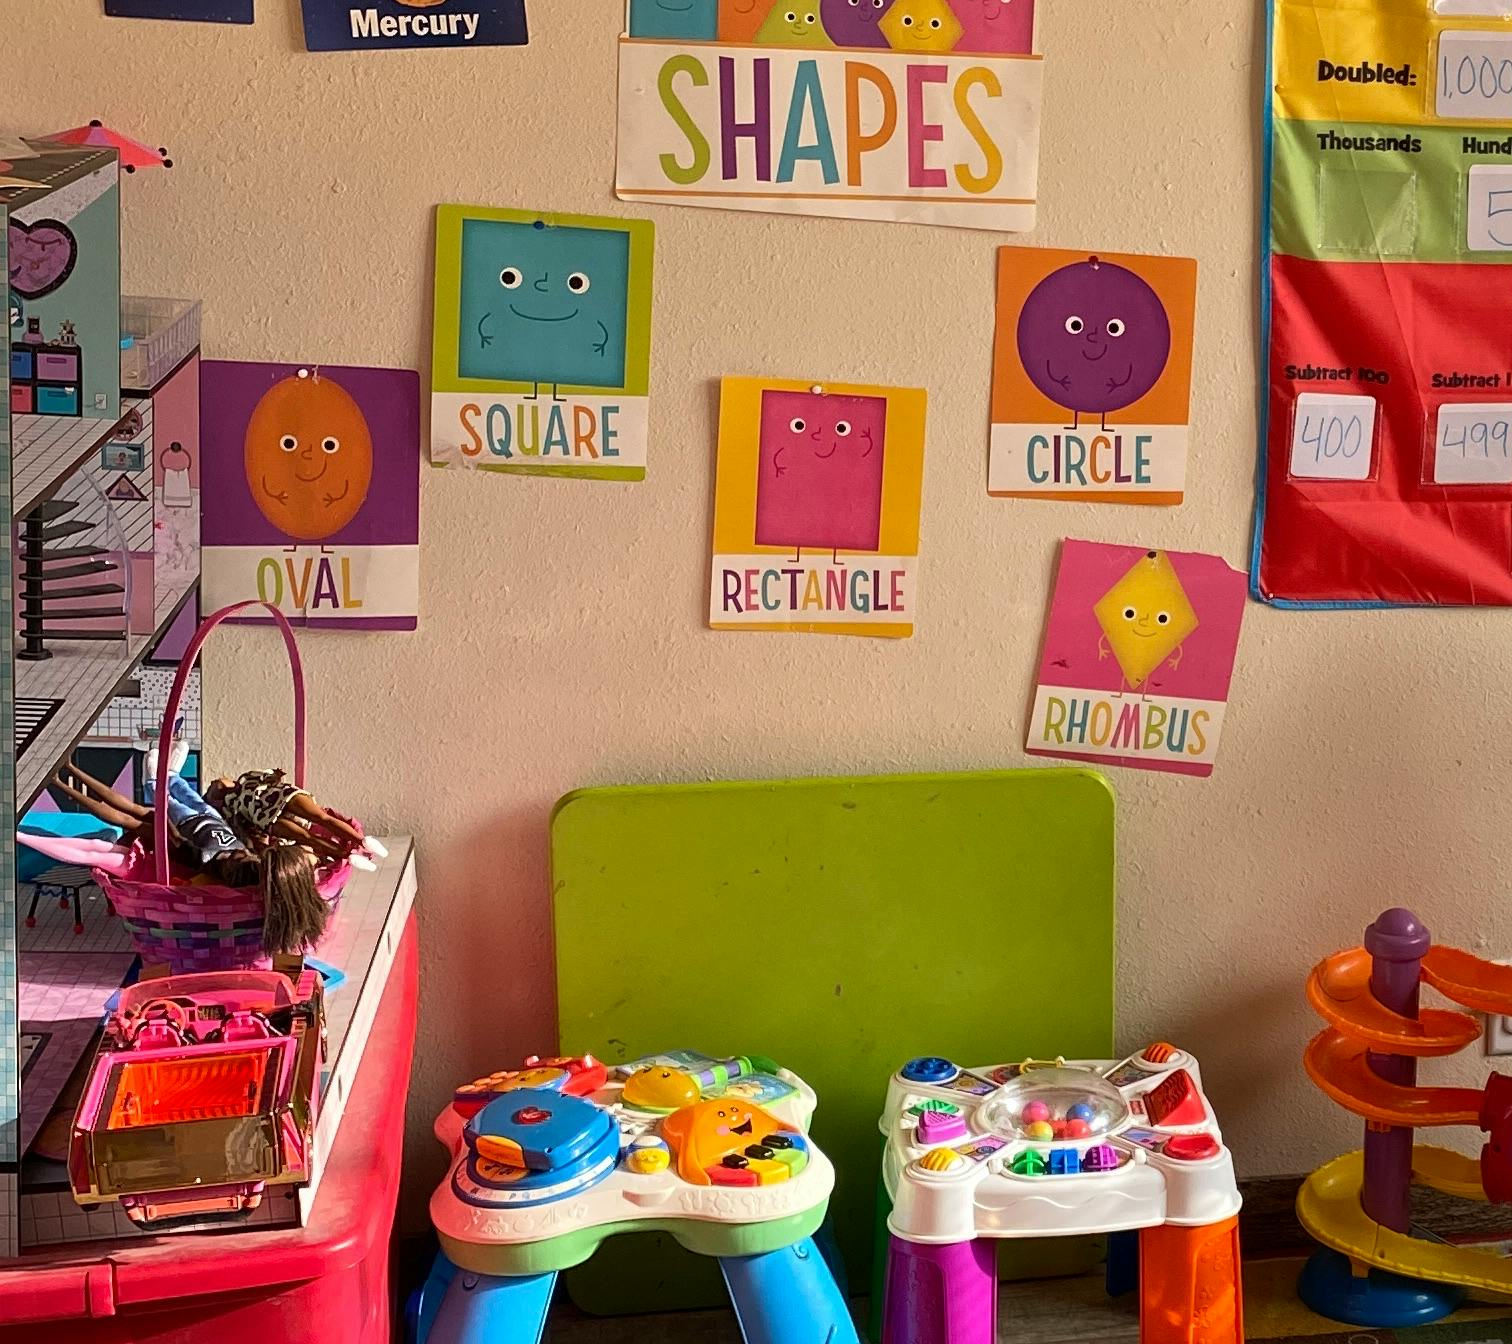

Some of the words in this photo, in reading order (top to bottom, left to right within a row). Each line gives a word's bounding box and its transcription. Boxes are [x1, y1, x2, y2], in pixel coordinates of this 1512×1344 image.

[350, 9, 480, 40] Mercury
[1317, 59, 1417, 86] Doubled:
[657, 54, 1003, 194] SHAPES
[1317, 130, 1422, 153] Thousands
[1285, 364, 1353, 381] Subtract
[1358, 368, 1390, 385] 100
[1431, 373, 1501, 389] Subtract
[460, 403, 620, 459] SQUARE
[1301, 415, 1362, 463] 400
[1442, 421, 1509, 458] 499
[1027, 435, 1153, 486] CIRCLE
[257, 557, 362, 609] OVAL
[721, 568, 906, 613] RECTANGLE
[1043, 696, 1209, 755] RHOMBUS
